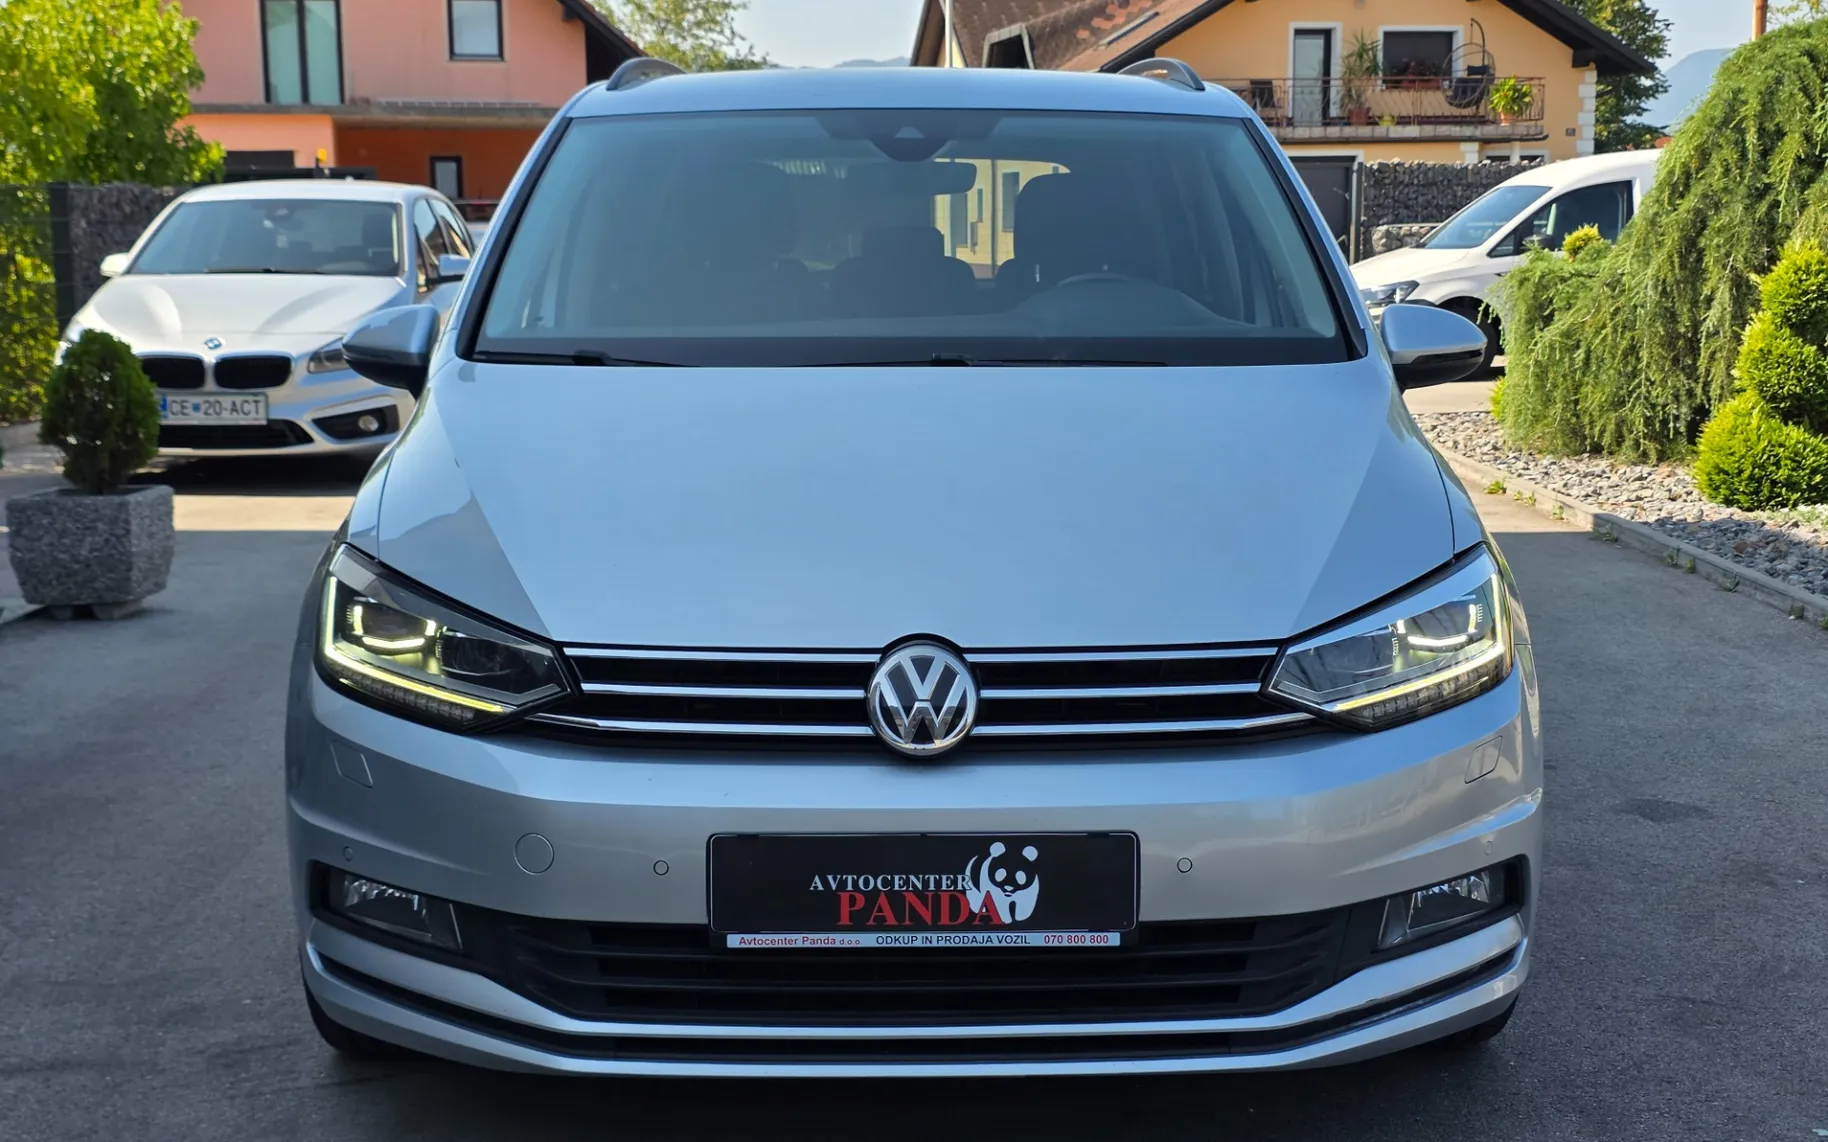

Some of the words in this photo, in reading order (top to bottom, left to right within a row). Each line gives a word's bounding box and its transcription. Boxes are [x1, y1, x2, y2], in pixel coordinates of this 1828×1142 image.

[170, 399, 190, 416] CE
[203, 399, 262, 417] 20-ACT
[809, 874, 972, 891] AVTOCENTER
[836, 891, 1005, 925] PANDA
[738, 937, 798, 946] Avtocenter
[801, 936, 836, 946] Panda
[875, 935, 918, 946] ODKUP
[921, 935, 933, 945] IN
[936, 934, 993, 945] PRODAJA
[996, 934, 1030, 945] VOZIL
[1043, 934, 1063, 945] 070
[1066, 934, 1086, 945] 800
[1089, 934, 1109, 945] 800
